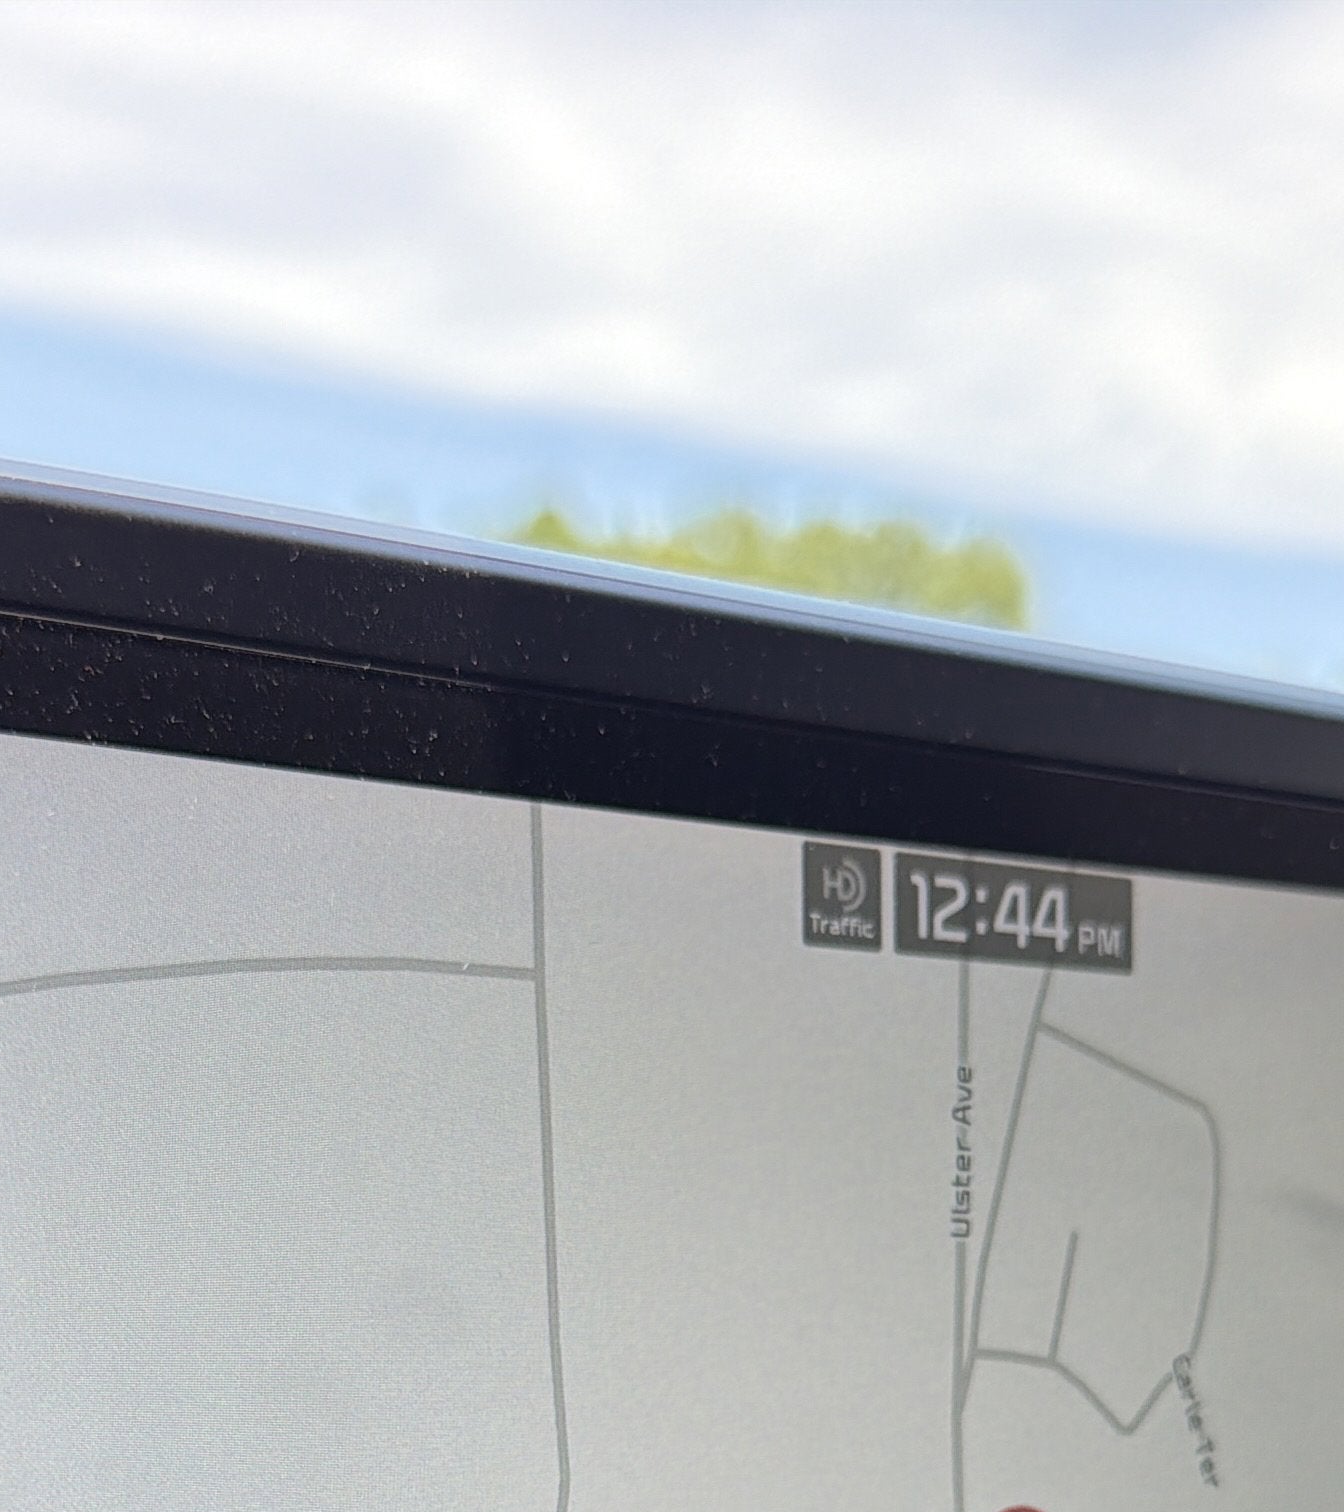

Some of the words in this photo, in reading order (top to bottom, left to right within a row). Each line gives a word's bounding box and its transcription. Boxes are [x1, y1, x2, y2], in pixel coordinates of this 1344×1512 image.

[809, 911, 877, 941] Traffic
[910, 869, 1070, 953] 12:44
[1077, 925, 1124, 960] PM
[951, 1065, 973, 1127] Ave
[950, 1137, 973, 1239] Ulster
